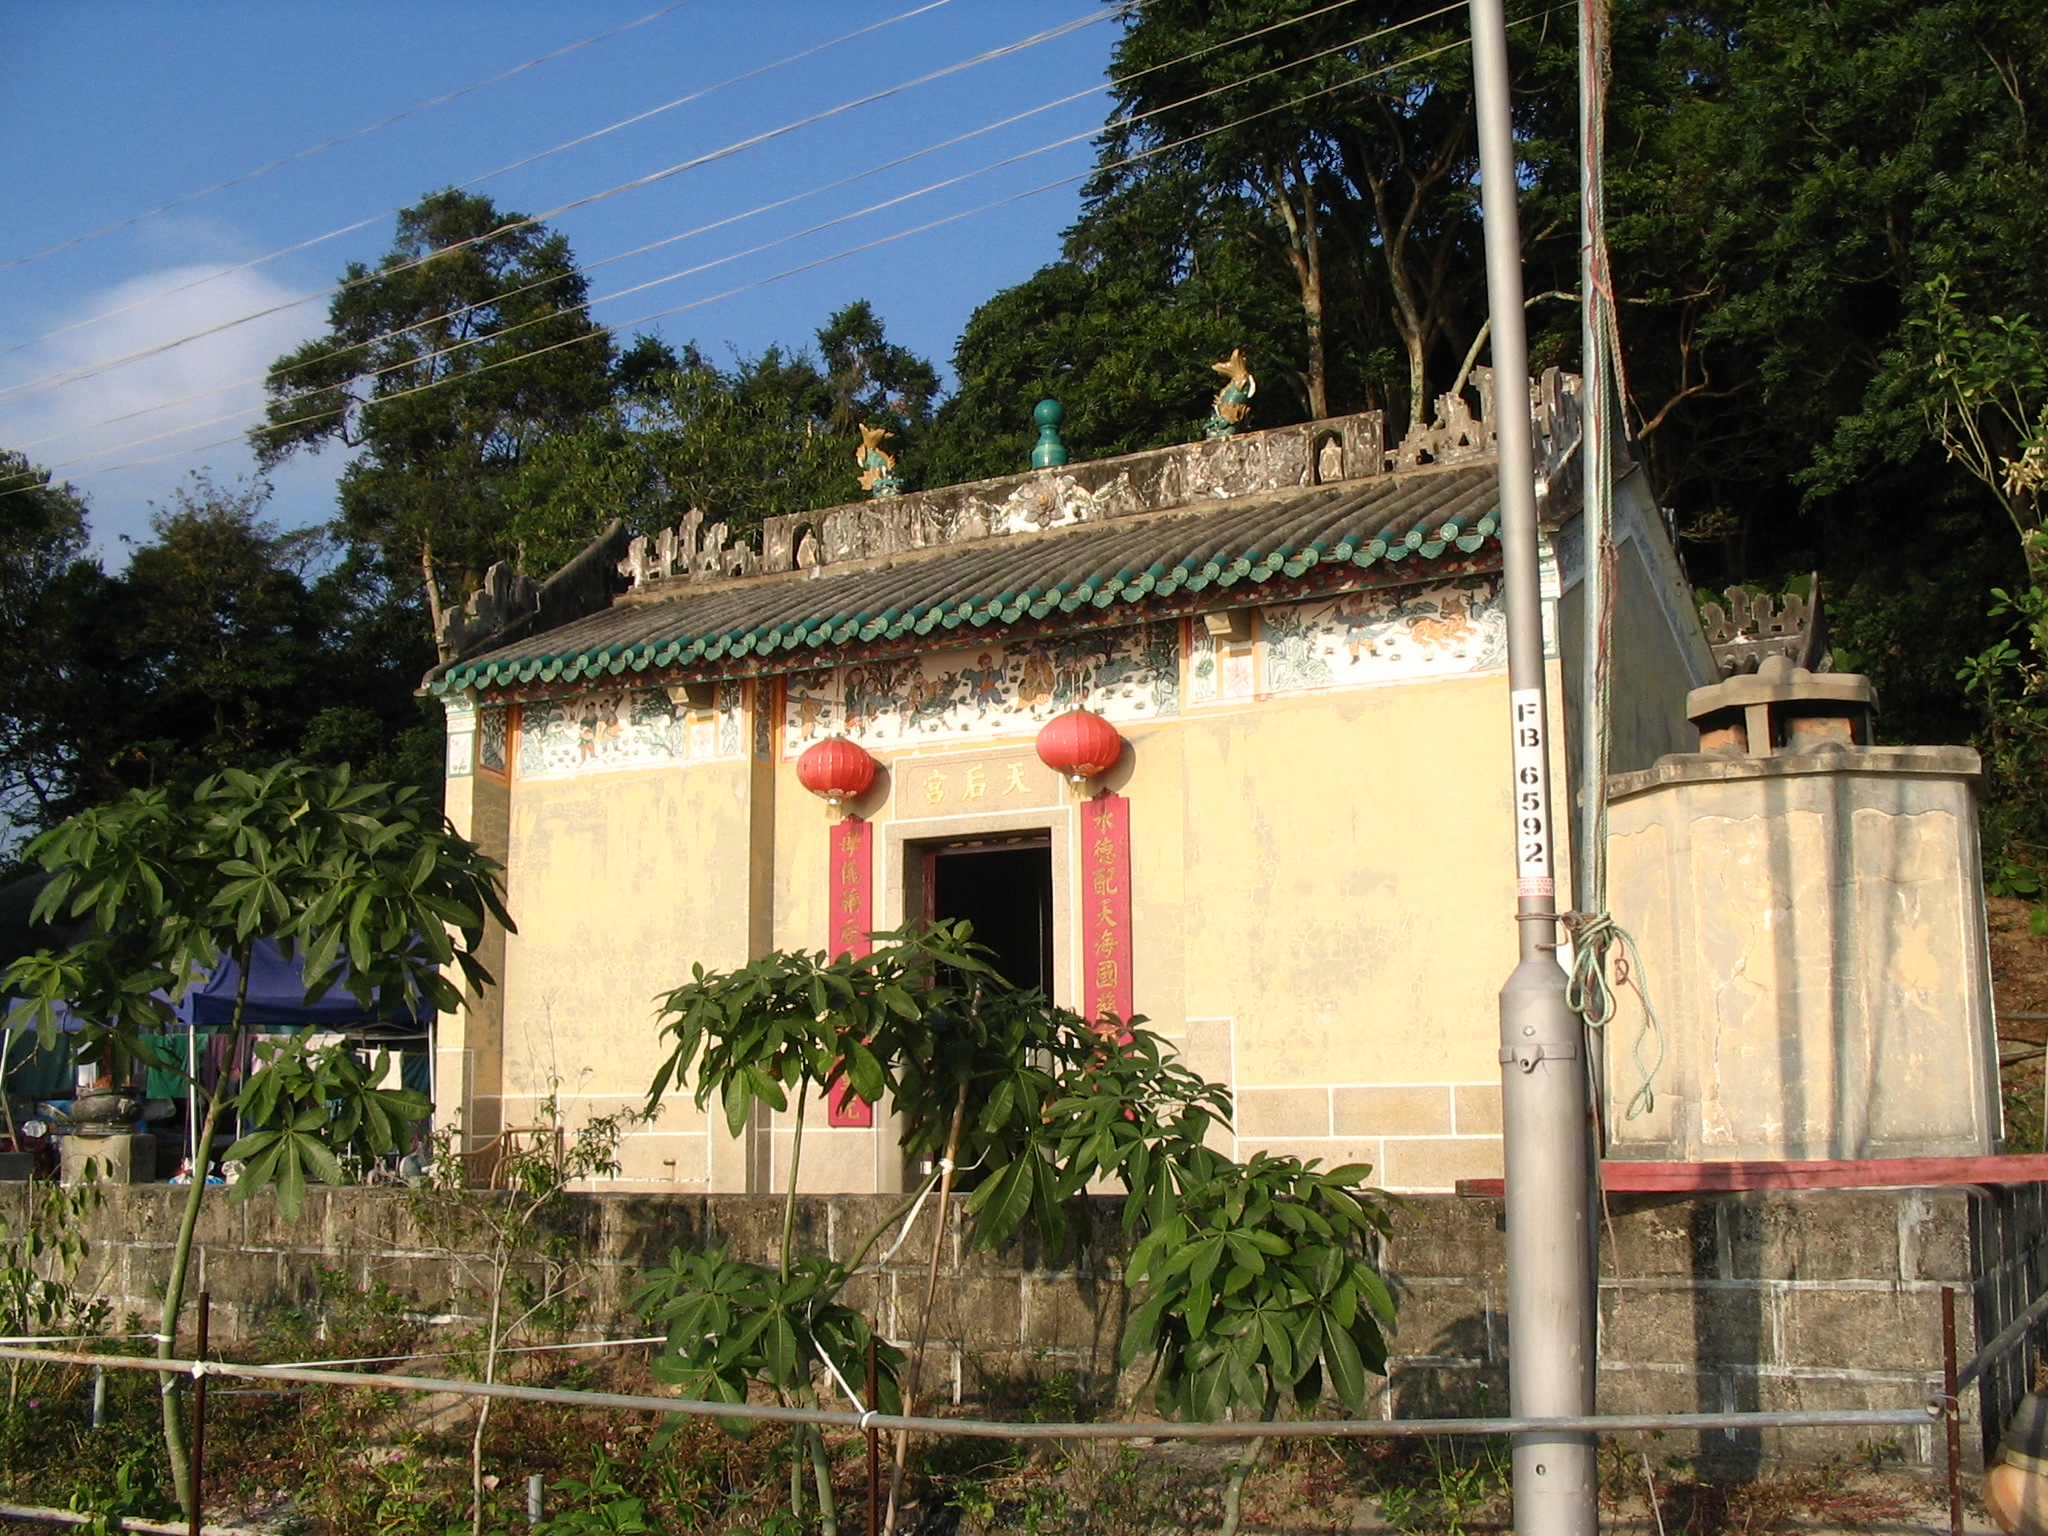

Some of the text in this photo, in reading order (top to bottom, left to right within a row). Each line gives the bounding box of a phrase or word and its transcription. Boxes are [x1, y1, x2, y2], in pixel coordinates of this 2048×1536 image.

[1517, 702, 1540, 748] FB
[922, 761, 1032, 805] 天后宮
[1519, 765, 1543, 863] 6592
